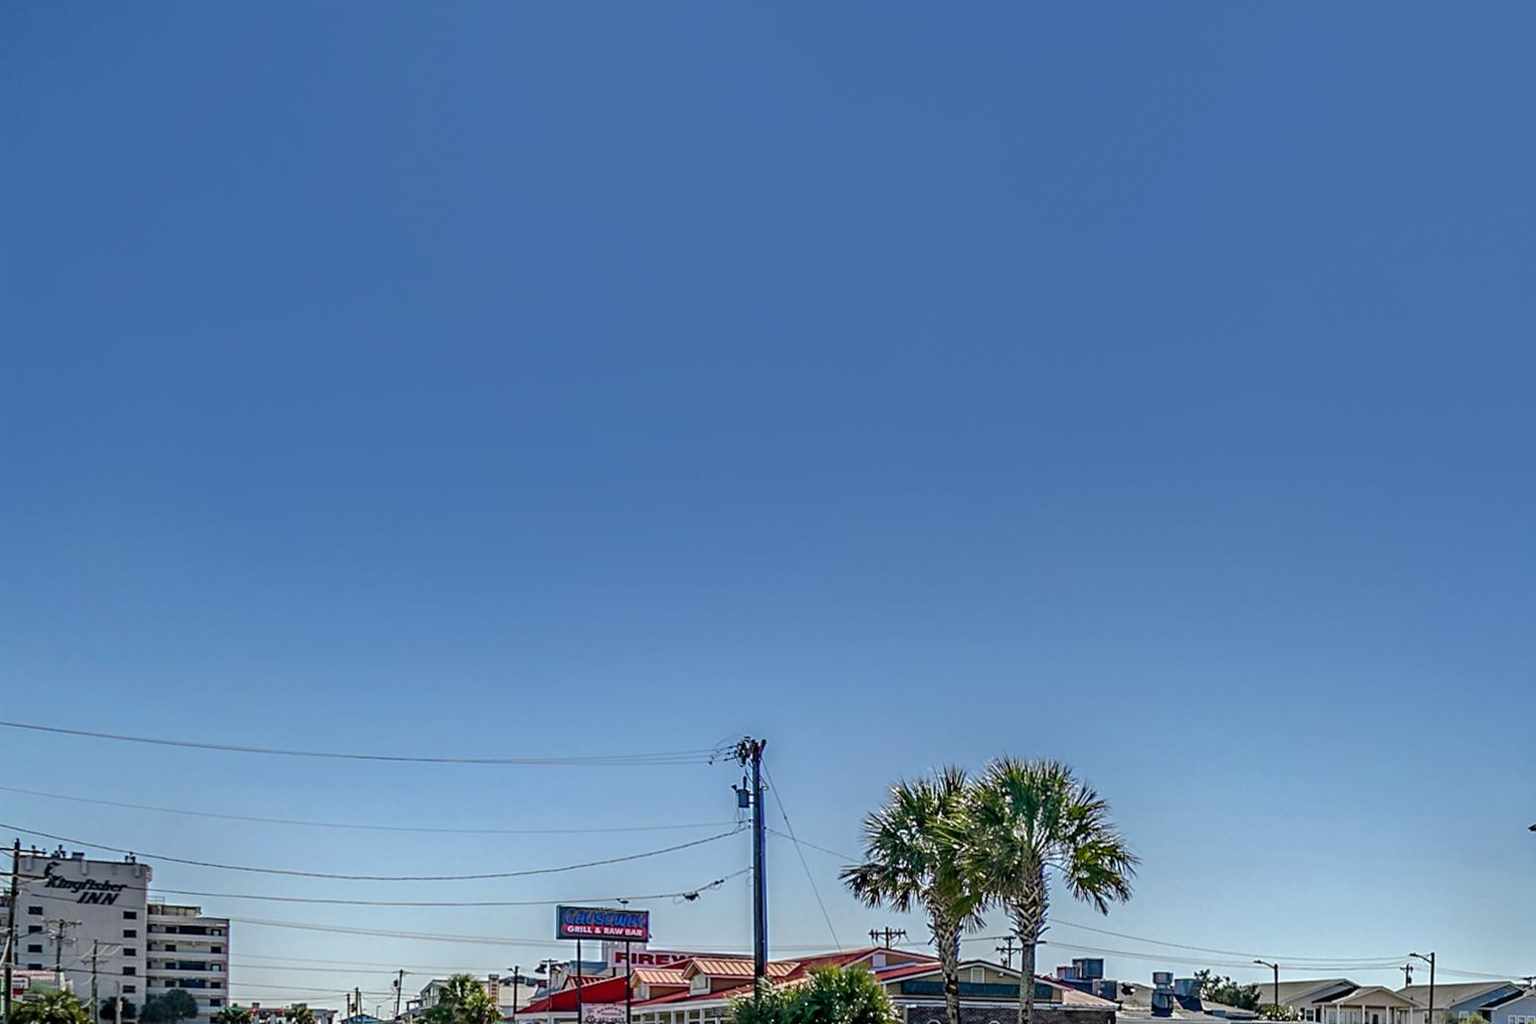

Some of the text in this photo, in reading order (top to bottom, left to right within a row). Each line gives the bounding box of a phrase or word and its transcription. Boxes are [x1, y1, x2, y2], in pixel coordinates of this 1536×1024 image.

[44, 876, 128, 893] Kingfisher
[77, 892, 119, 905] INN
[567, 925, 592, 934] GRILL
[604, 927, 624, 935] RAW
[625, 928, 643, 936] BAR
